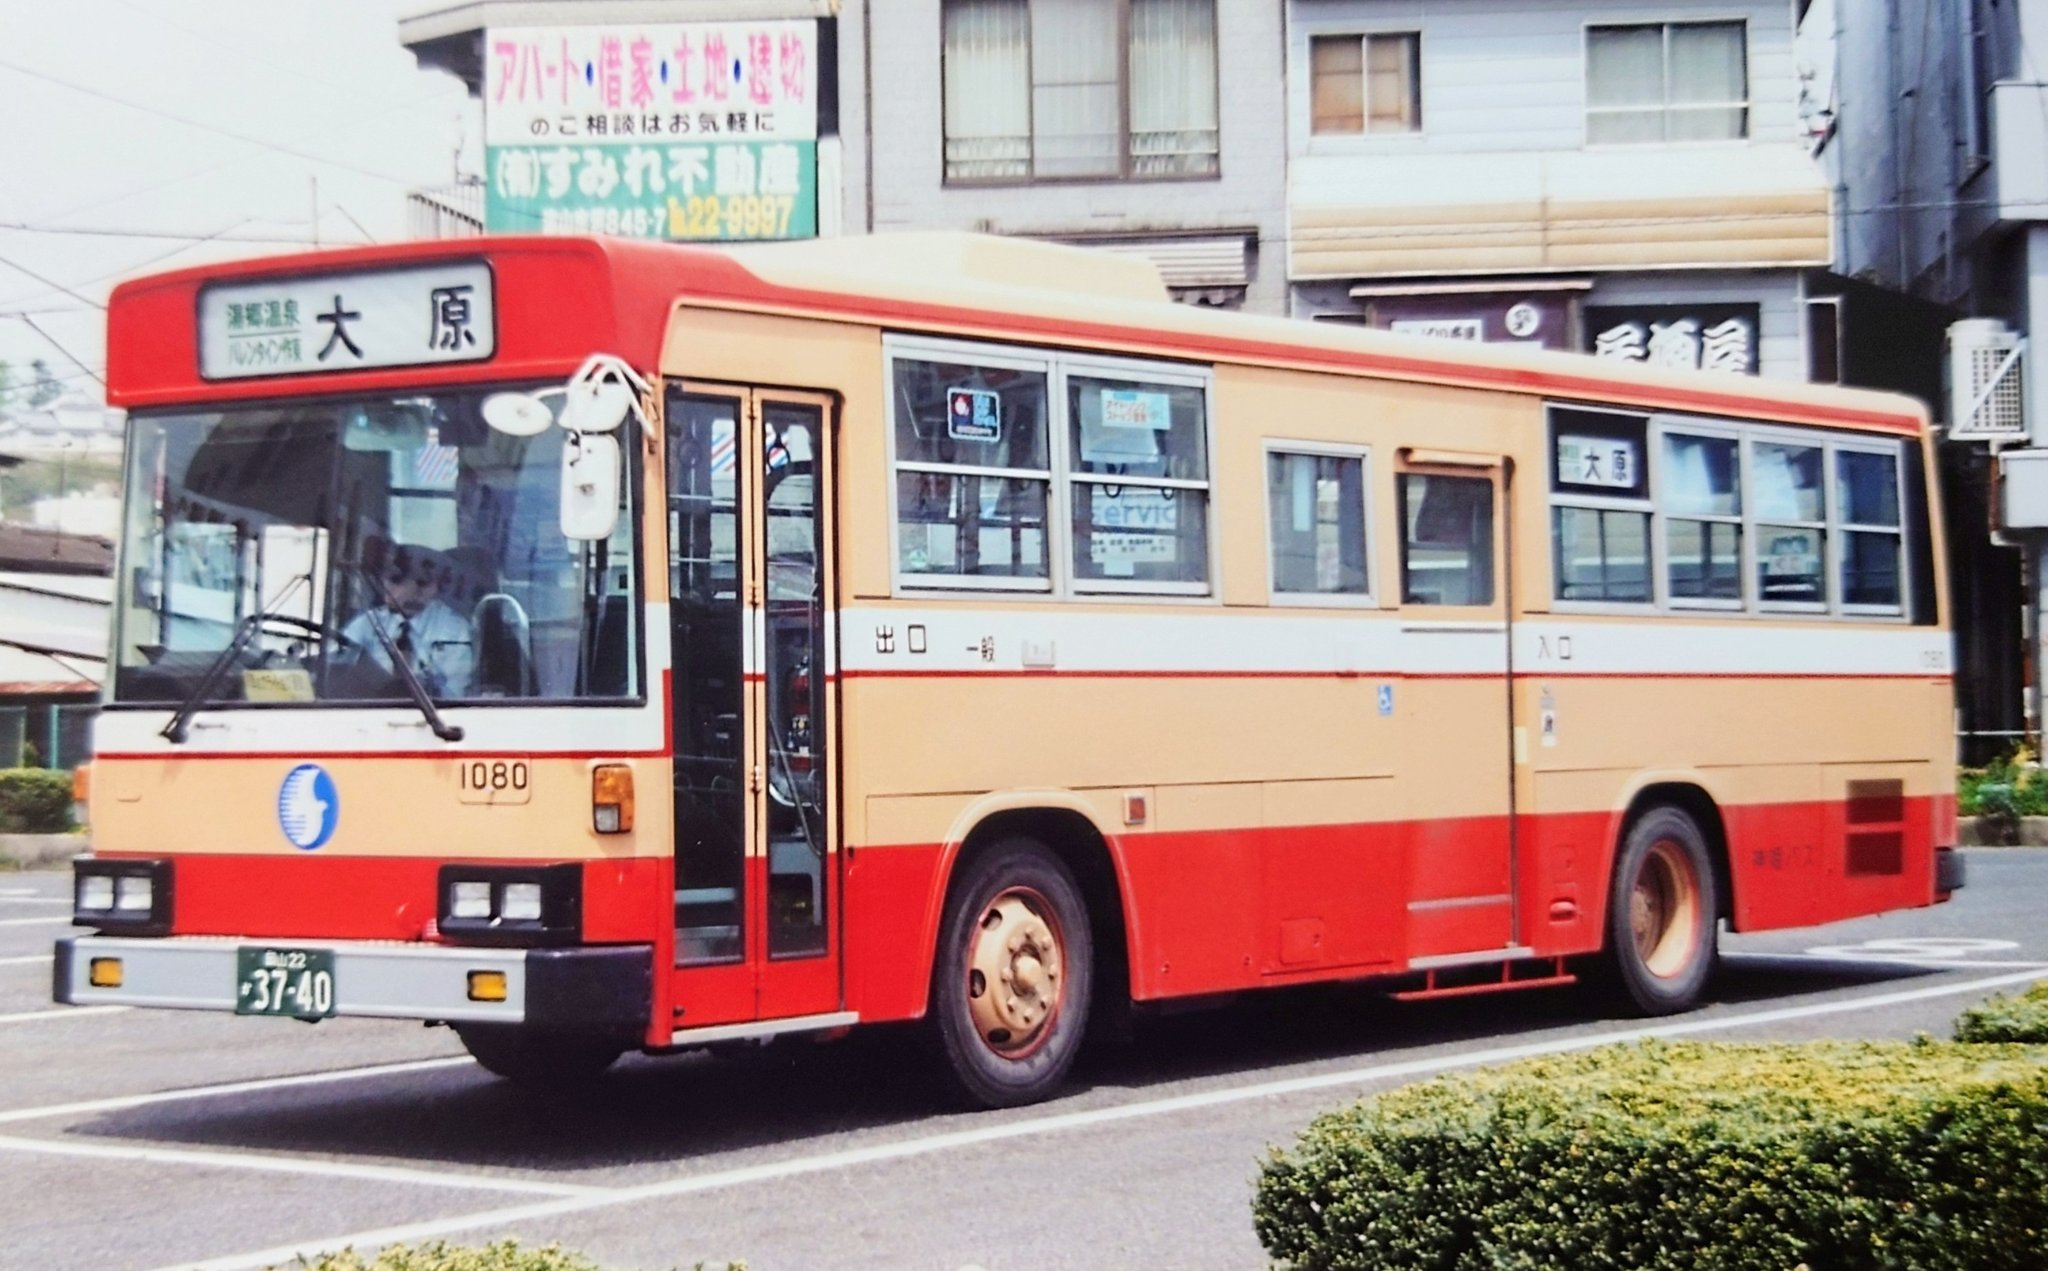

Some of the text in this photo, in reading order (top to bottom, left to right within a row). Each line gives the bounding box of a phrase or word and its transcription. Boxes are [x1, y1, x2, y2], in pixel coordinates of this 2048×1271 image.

[530, 112, 776, 137] のご相談はお気軽に
[316, 285, 477, 361] 大原
[1584, 446, 1627, 481] 大原
[875, 624, 927, 654] 出口
[1538, 635, 1571, 660] 入口
[461, 762, 528, 790] 1080
